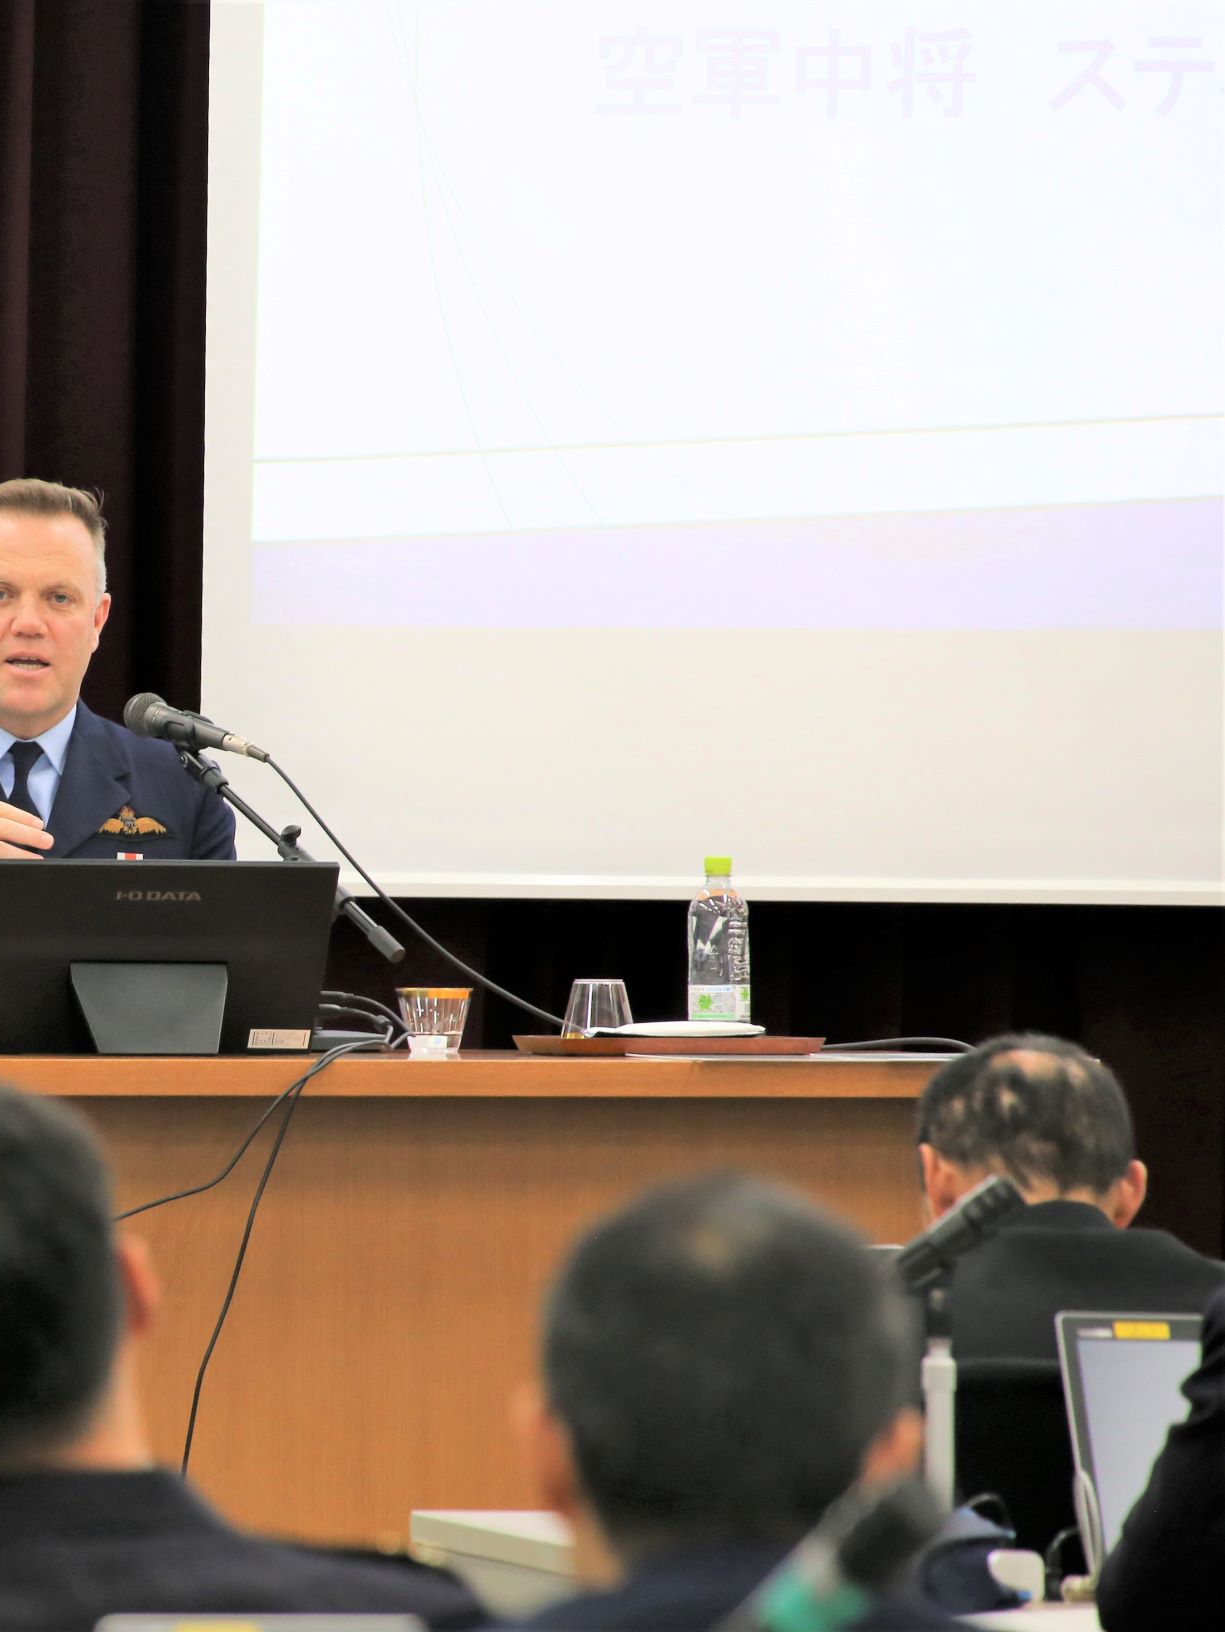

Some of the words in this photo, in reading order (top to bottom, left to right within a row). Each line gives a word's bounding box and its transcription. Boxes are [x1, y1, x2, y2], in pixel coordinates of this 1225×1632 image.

[595, 25, 978, 120] 空軍中将
[1047, 36, 1225, 118] ステ
[146, 890, 202, 901] DATA
